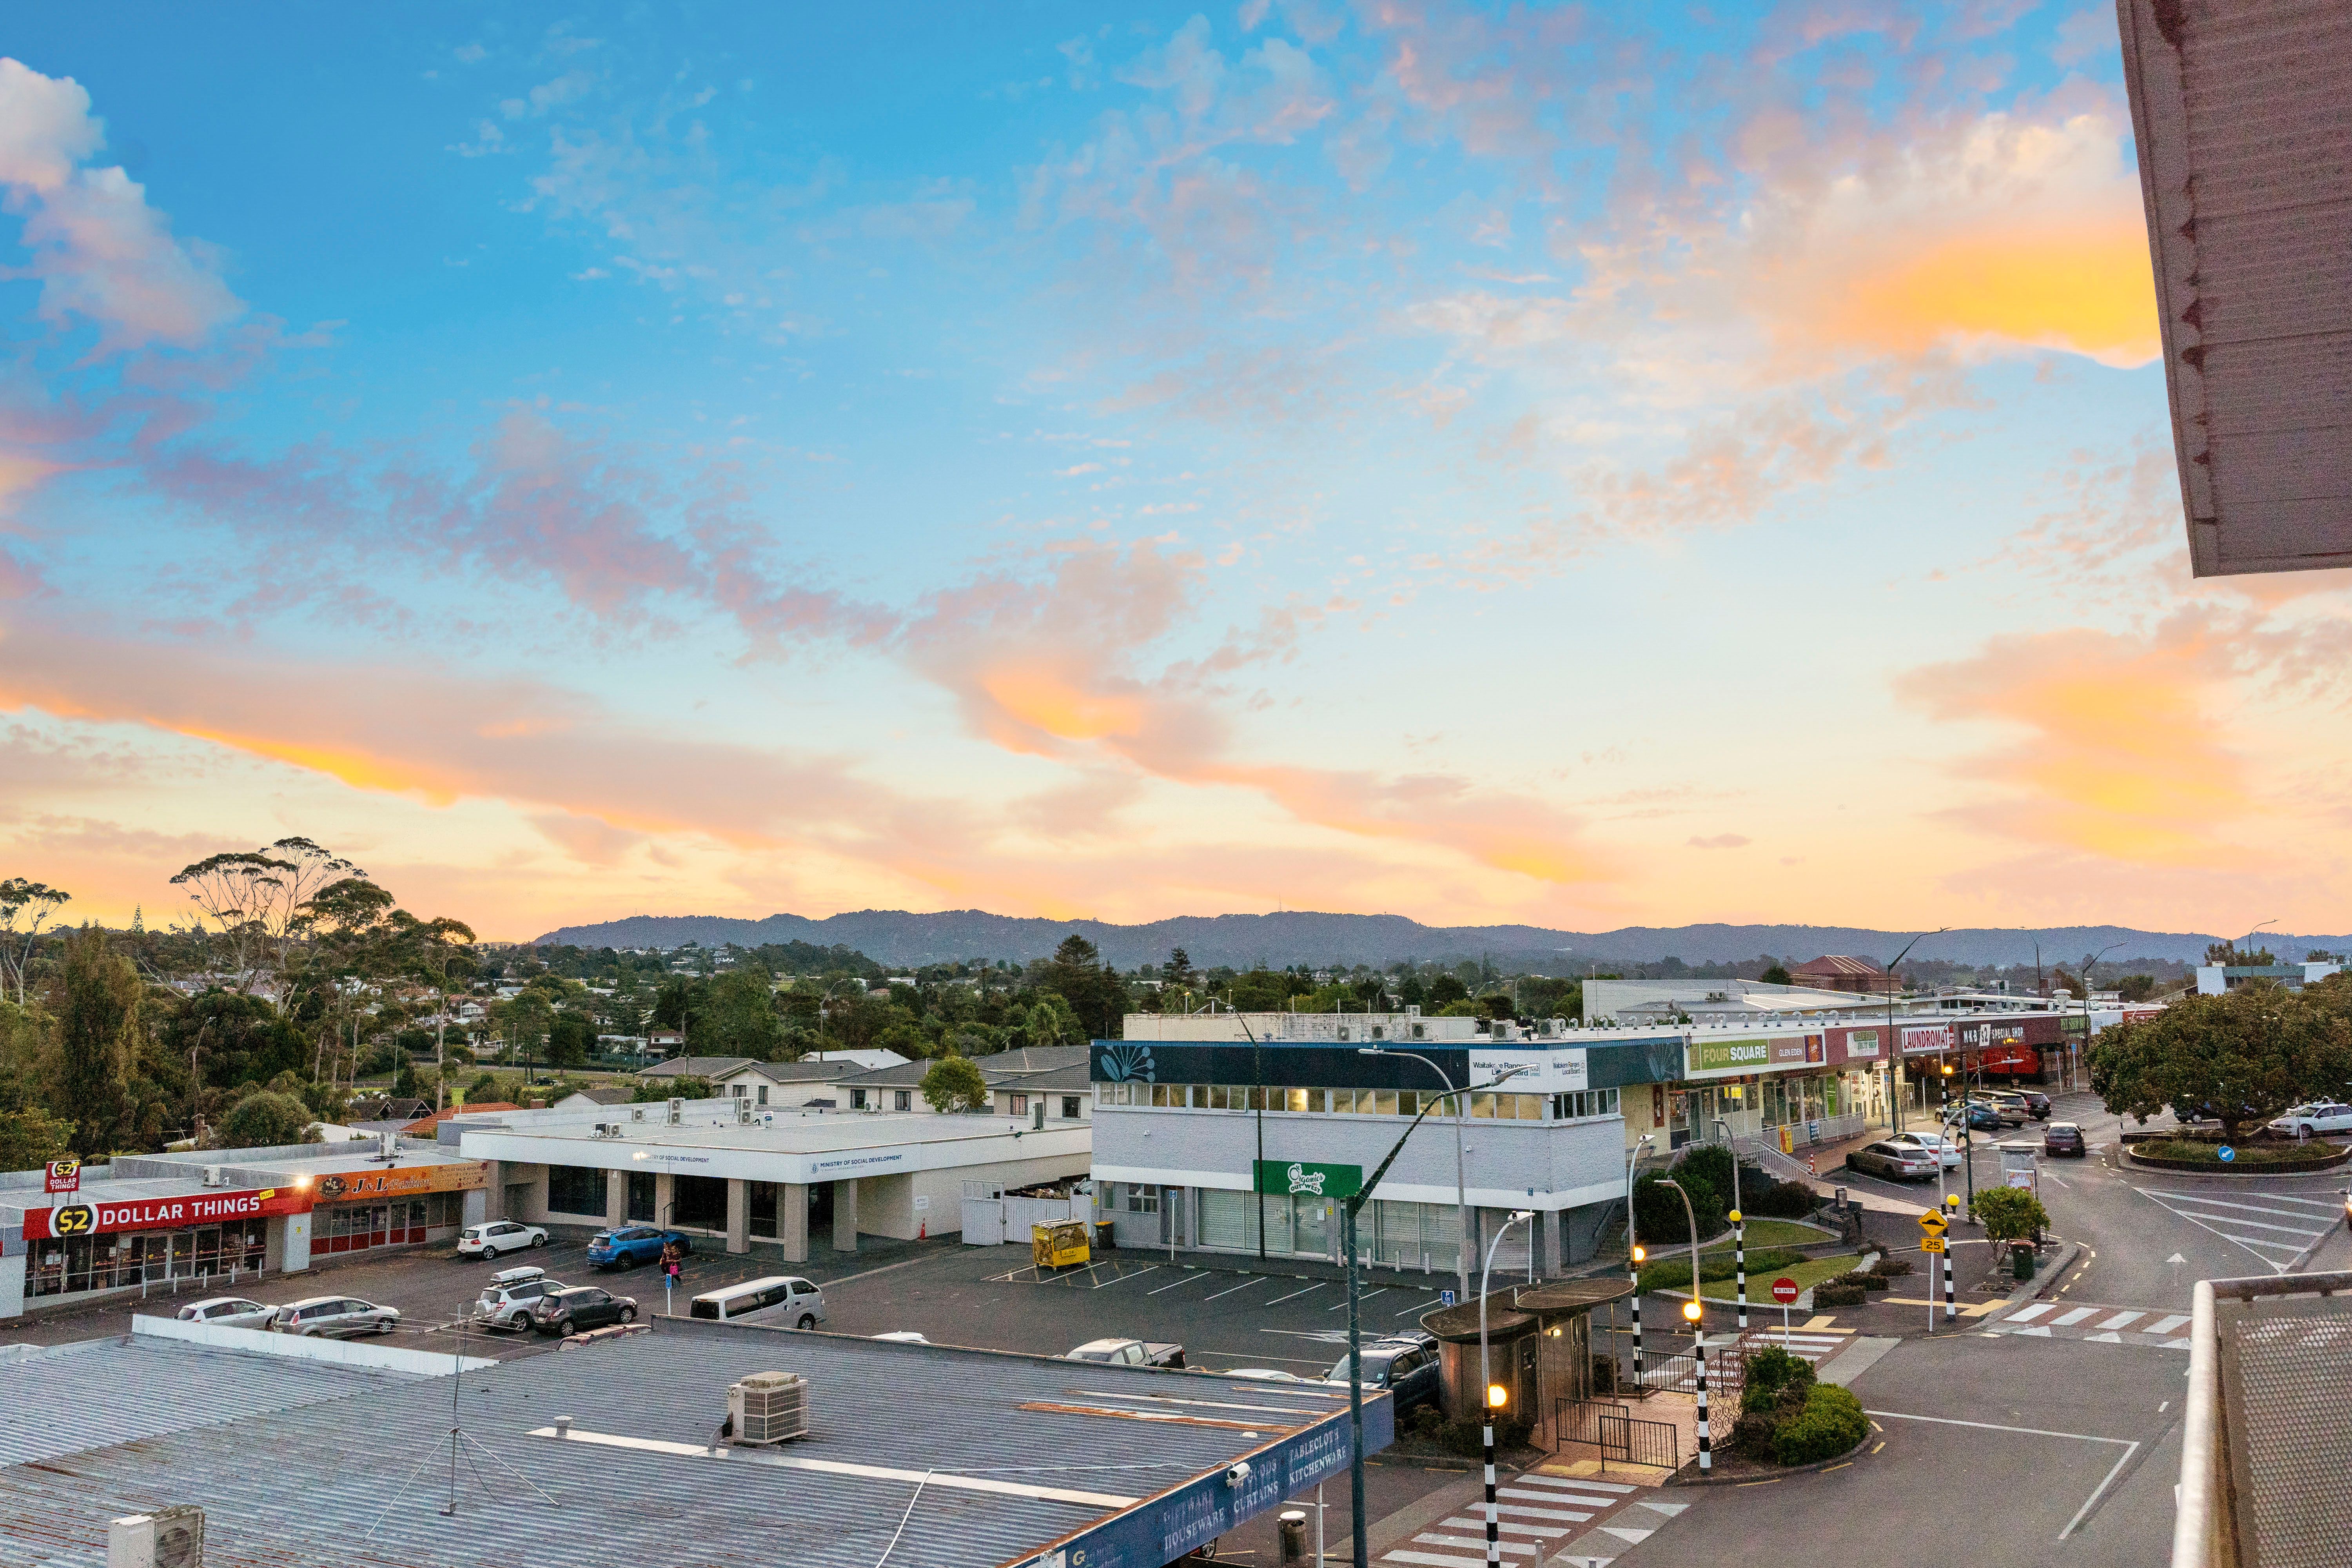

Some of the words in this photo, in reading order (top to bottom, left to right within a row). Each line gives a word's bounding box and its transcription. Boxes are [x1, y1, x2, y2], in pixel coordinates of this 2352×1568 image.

[1903, 1029, 1948, 1049] LAUNDROMAT
[1981, 1027, 1988, 1043] $2
[1992, 1028, 2011, 1040] SPECIAL
[2012, 1027, 2024, 1038] SHOP
[1704, 1048, 1730, 1062] FOUR
[1730, 1045, 1767, 1062] SQUARE
[1791, 1048, 1802, 1056] EDEN
[869, 1155, 902, 1163] DEVELOPMENT
[56, 1163, 71, 1175] $2
[1289, 1166, 1323, 1186] Organics
[352, 1178, 367, 1194] J
[365, 1183, 373, 1191] &
[374, 1176, 388, 1192] L
[1304, 1183, 1321, 1193] WEST
[103, 1204, 183, 1225] DOLLAR
[192, 1197, 260, 1217] THINGS
[59, 1210, 88, 1232] $2
[1926, 1241, 1940, 1249] 25
[1289, 1427, 1339, 1462] TABLECLOTH
[1289, 1445, 1347, 1486] KITCHENWARE
[1234, 1481, 1278, 1514] CURTAINS
[1164, 1507, 1225, 1550] HOUSEWARE
